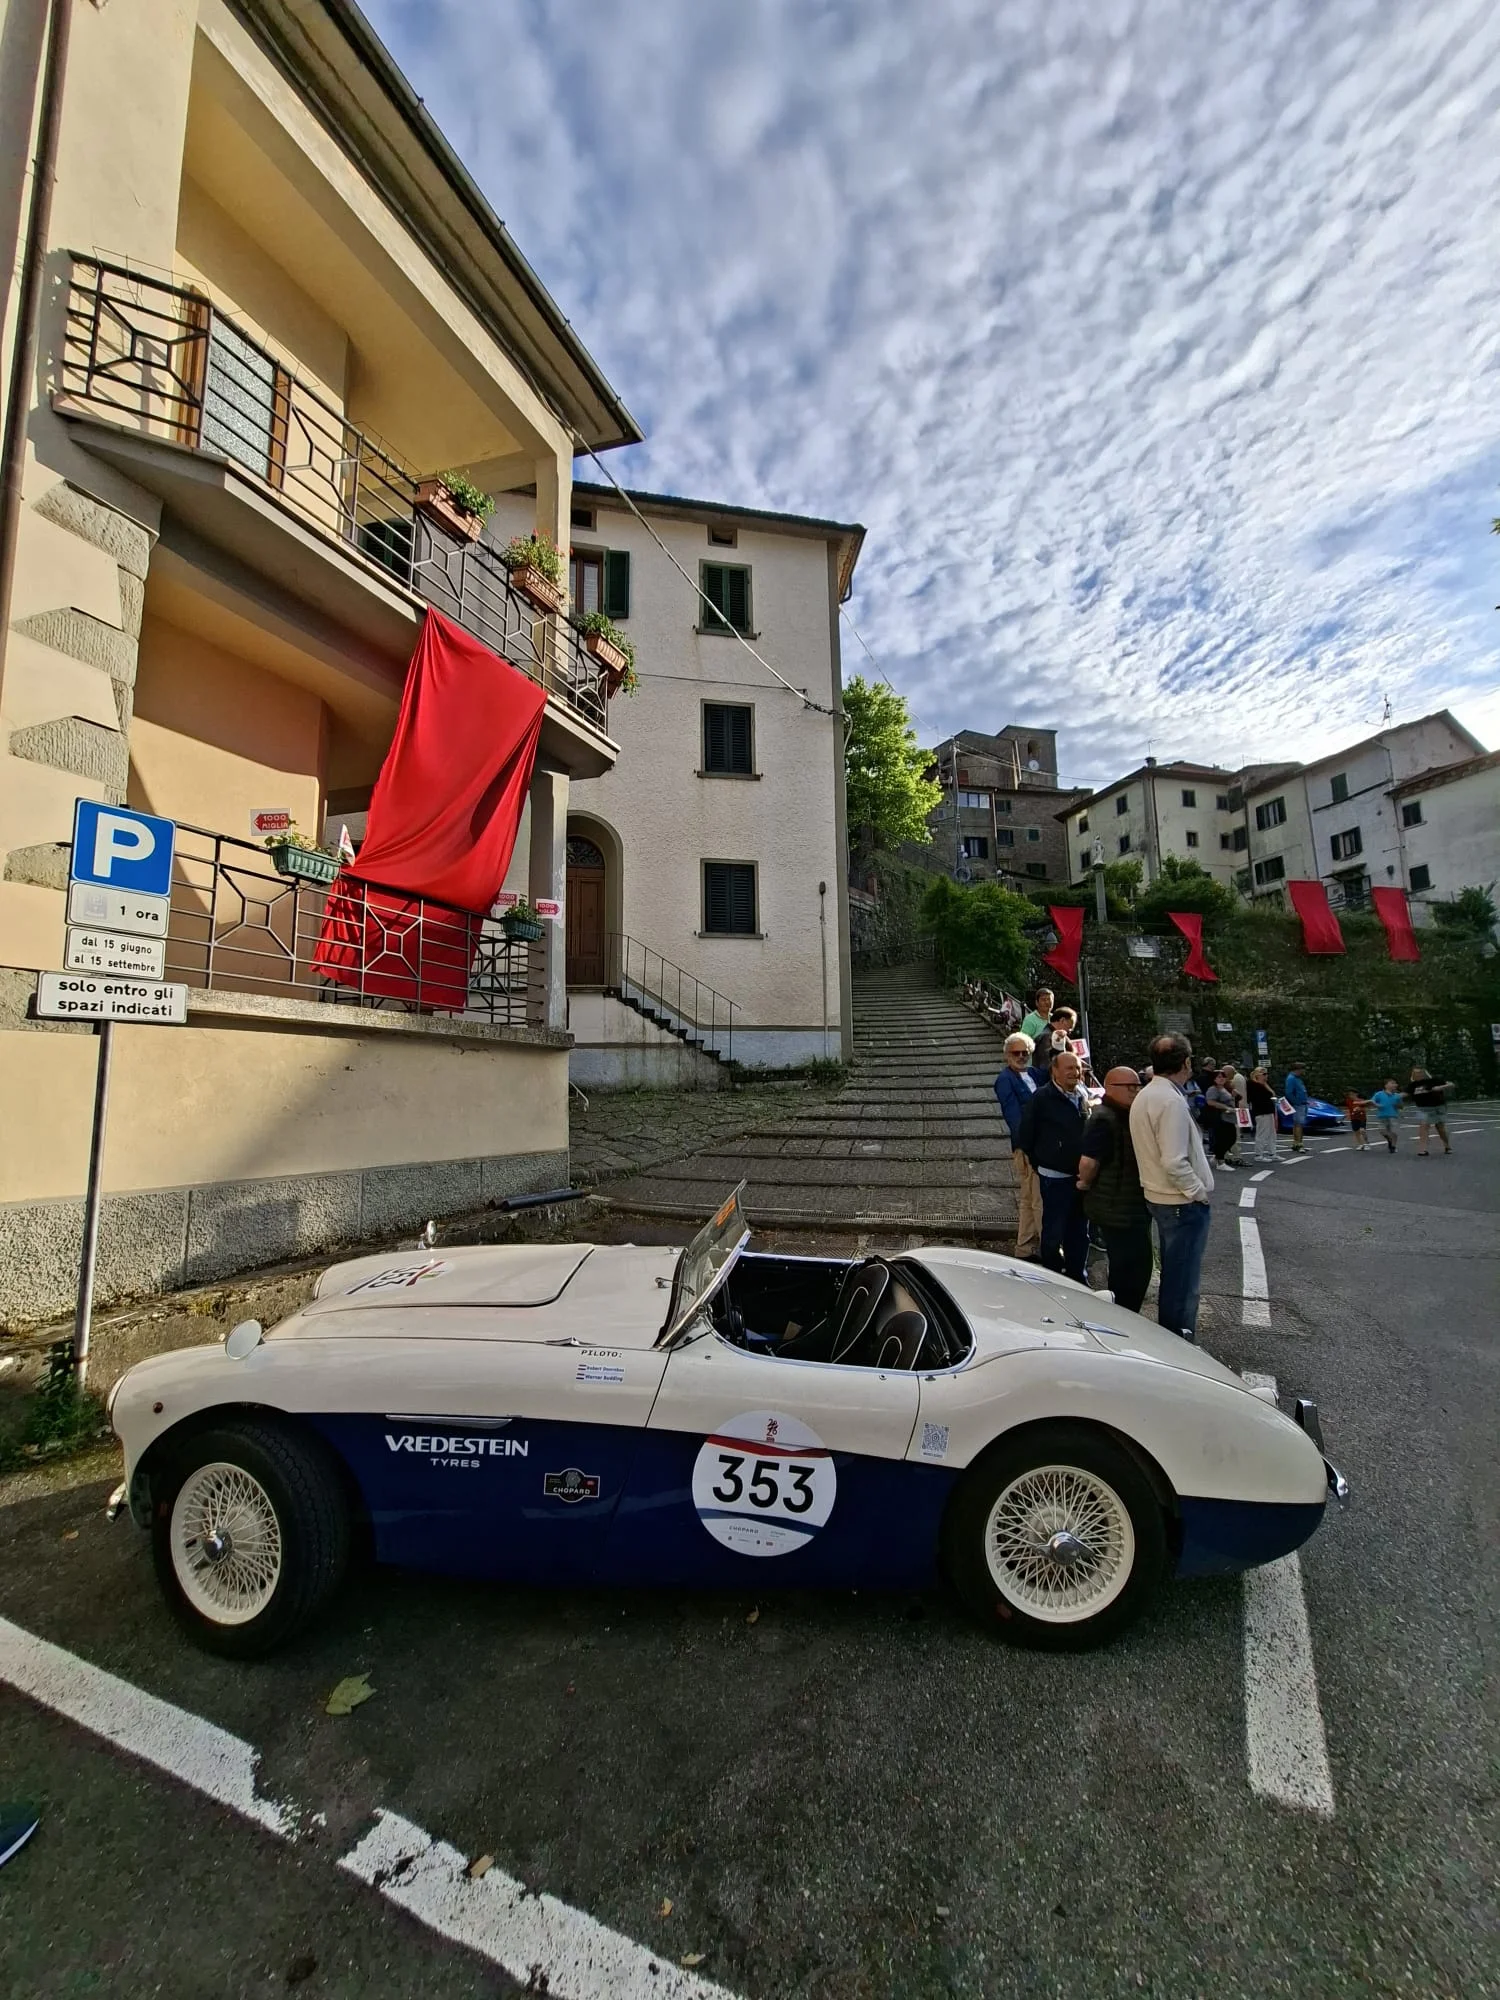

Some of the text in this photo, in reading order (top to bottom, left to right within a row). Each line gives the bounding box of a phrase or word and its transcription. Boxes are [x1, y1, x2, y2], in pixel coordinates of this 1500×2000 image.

[93, 811, 156, 878] P
[120, 905, 159, 921] 1 ora
[81, 936, 152, 955] dal 15 giugno
[74, 954, 156, 973] al 15 settembre
[58, 980, 174, 1001] solo entro gli
[57, 1000, 173, 1017] spazi indicati
[581, 1350, 622, 1358] PILOTO:
[385, 1434, 528, 1457] VREDESTEIN
[430, 1458, 480, 1468] TYRES
[553, 1487, 590, 1495] CHOPARD
[712, 1454, 815, 1514] 353
